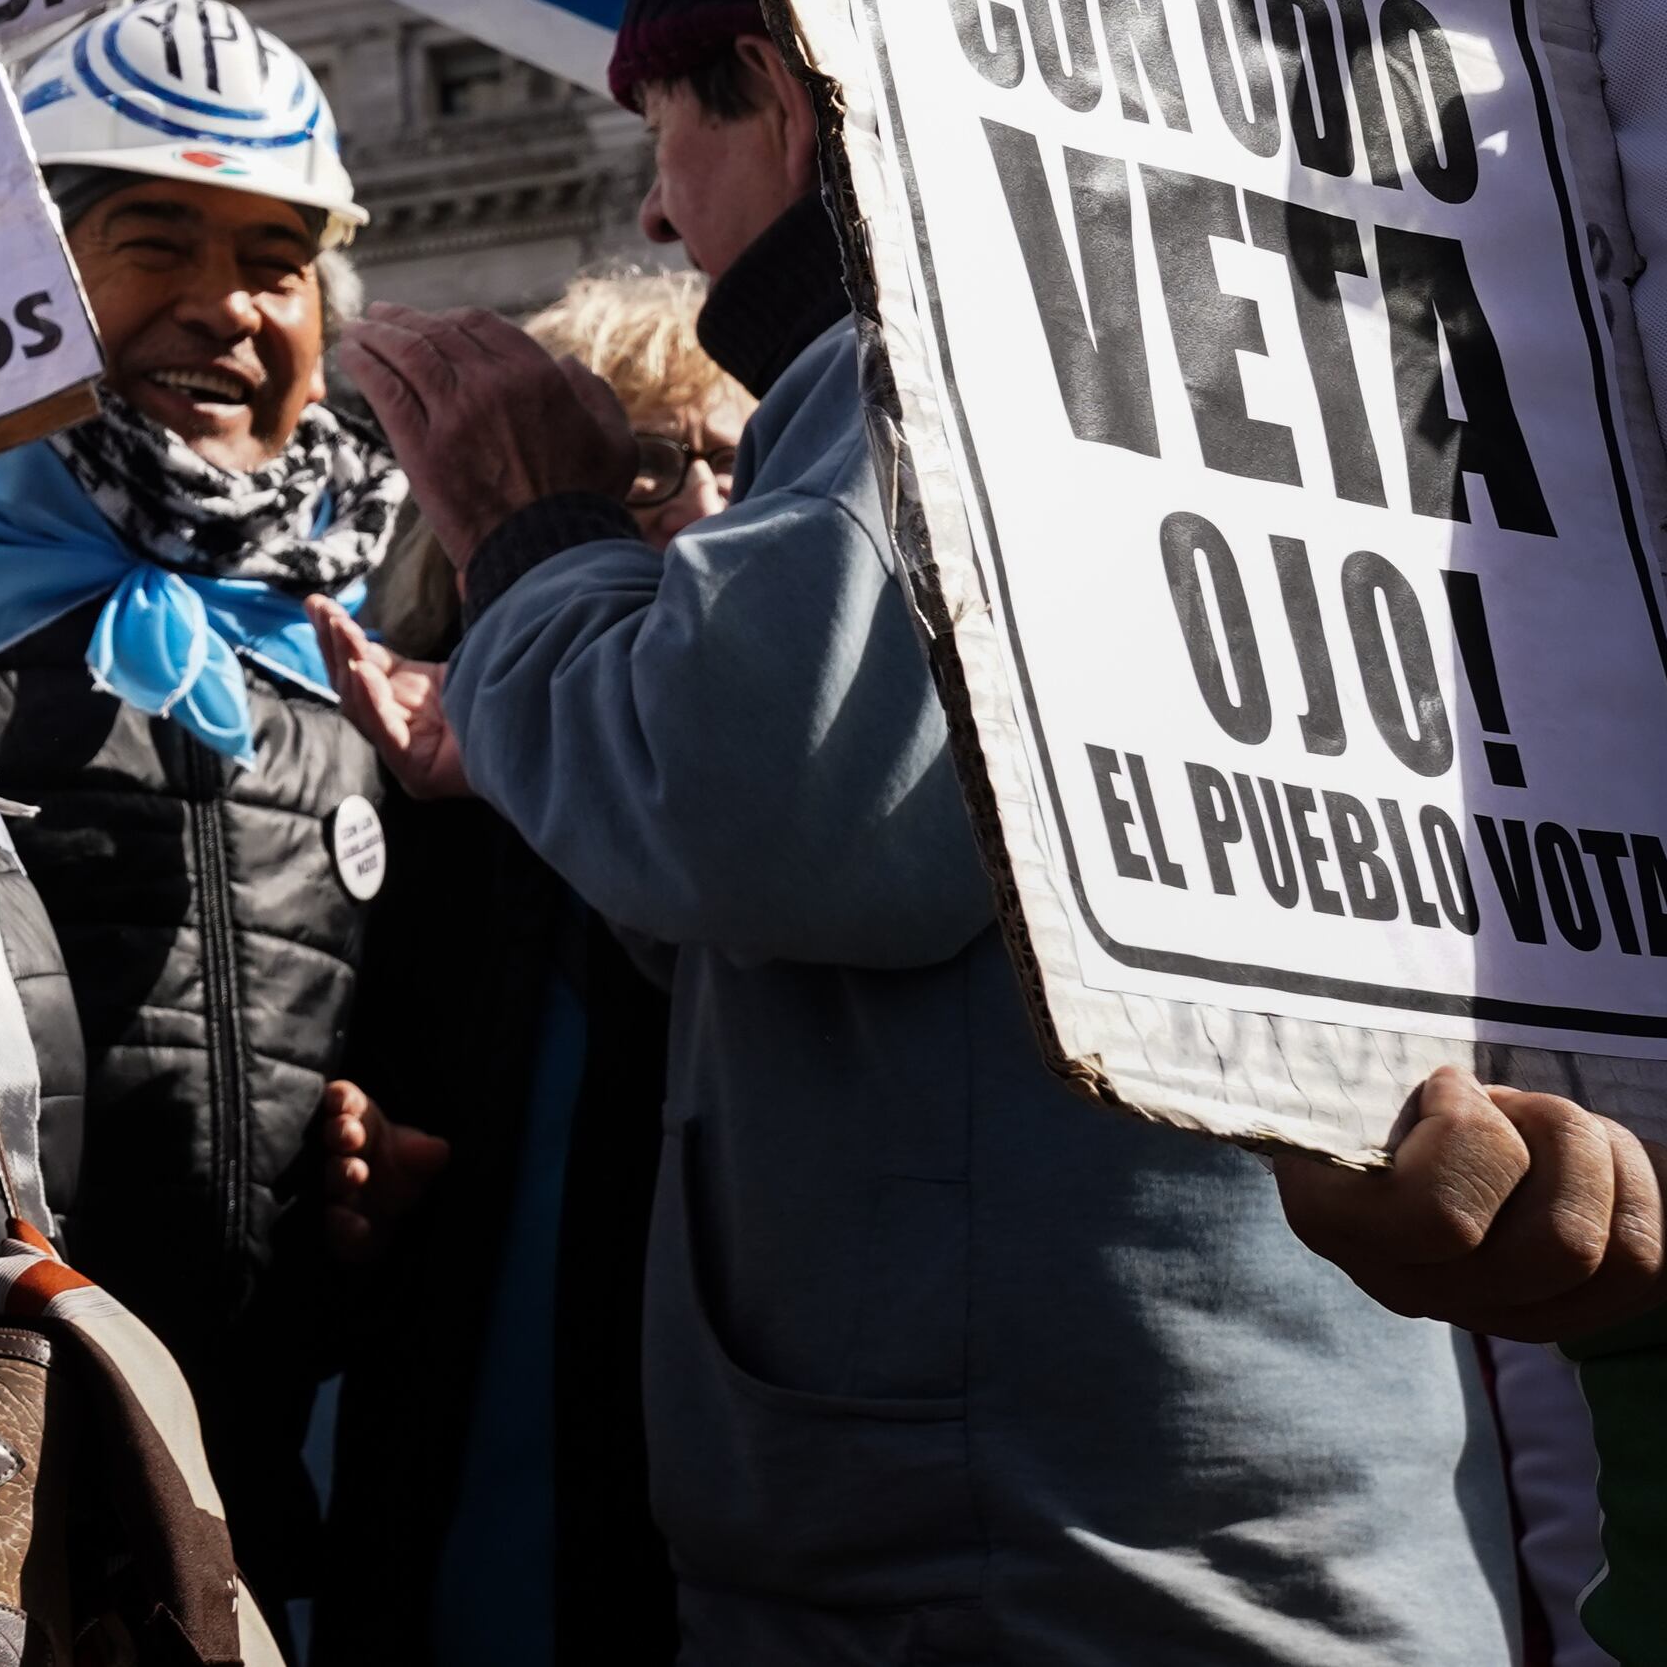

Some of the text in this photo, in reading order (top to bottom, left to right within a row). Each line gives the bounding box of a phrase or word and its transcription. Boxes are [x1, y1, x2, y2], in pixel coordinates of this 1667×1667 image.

[980, 117, 1558, 538] VETA
[1084, 741, 1187, 890] EL
[1184, 759, 1482, 938] PUEBLO
